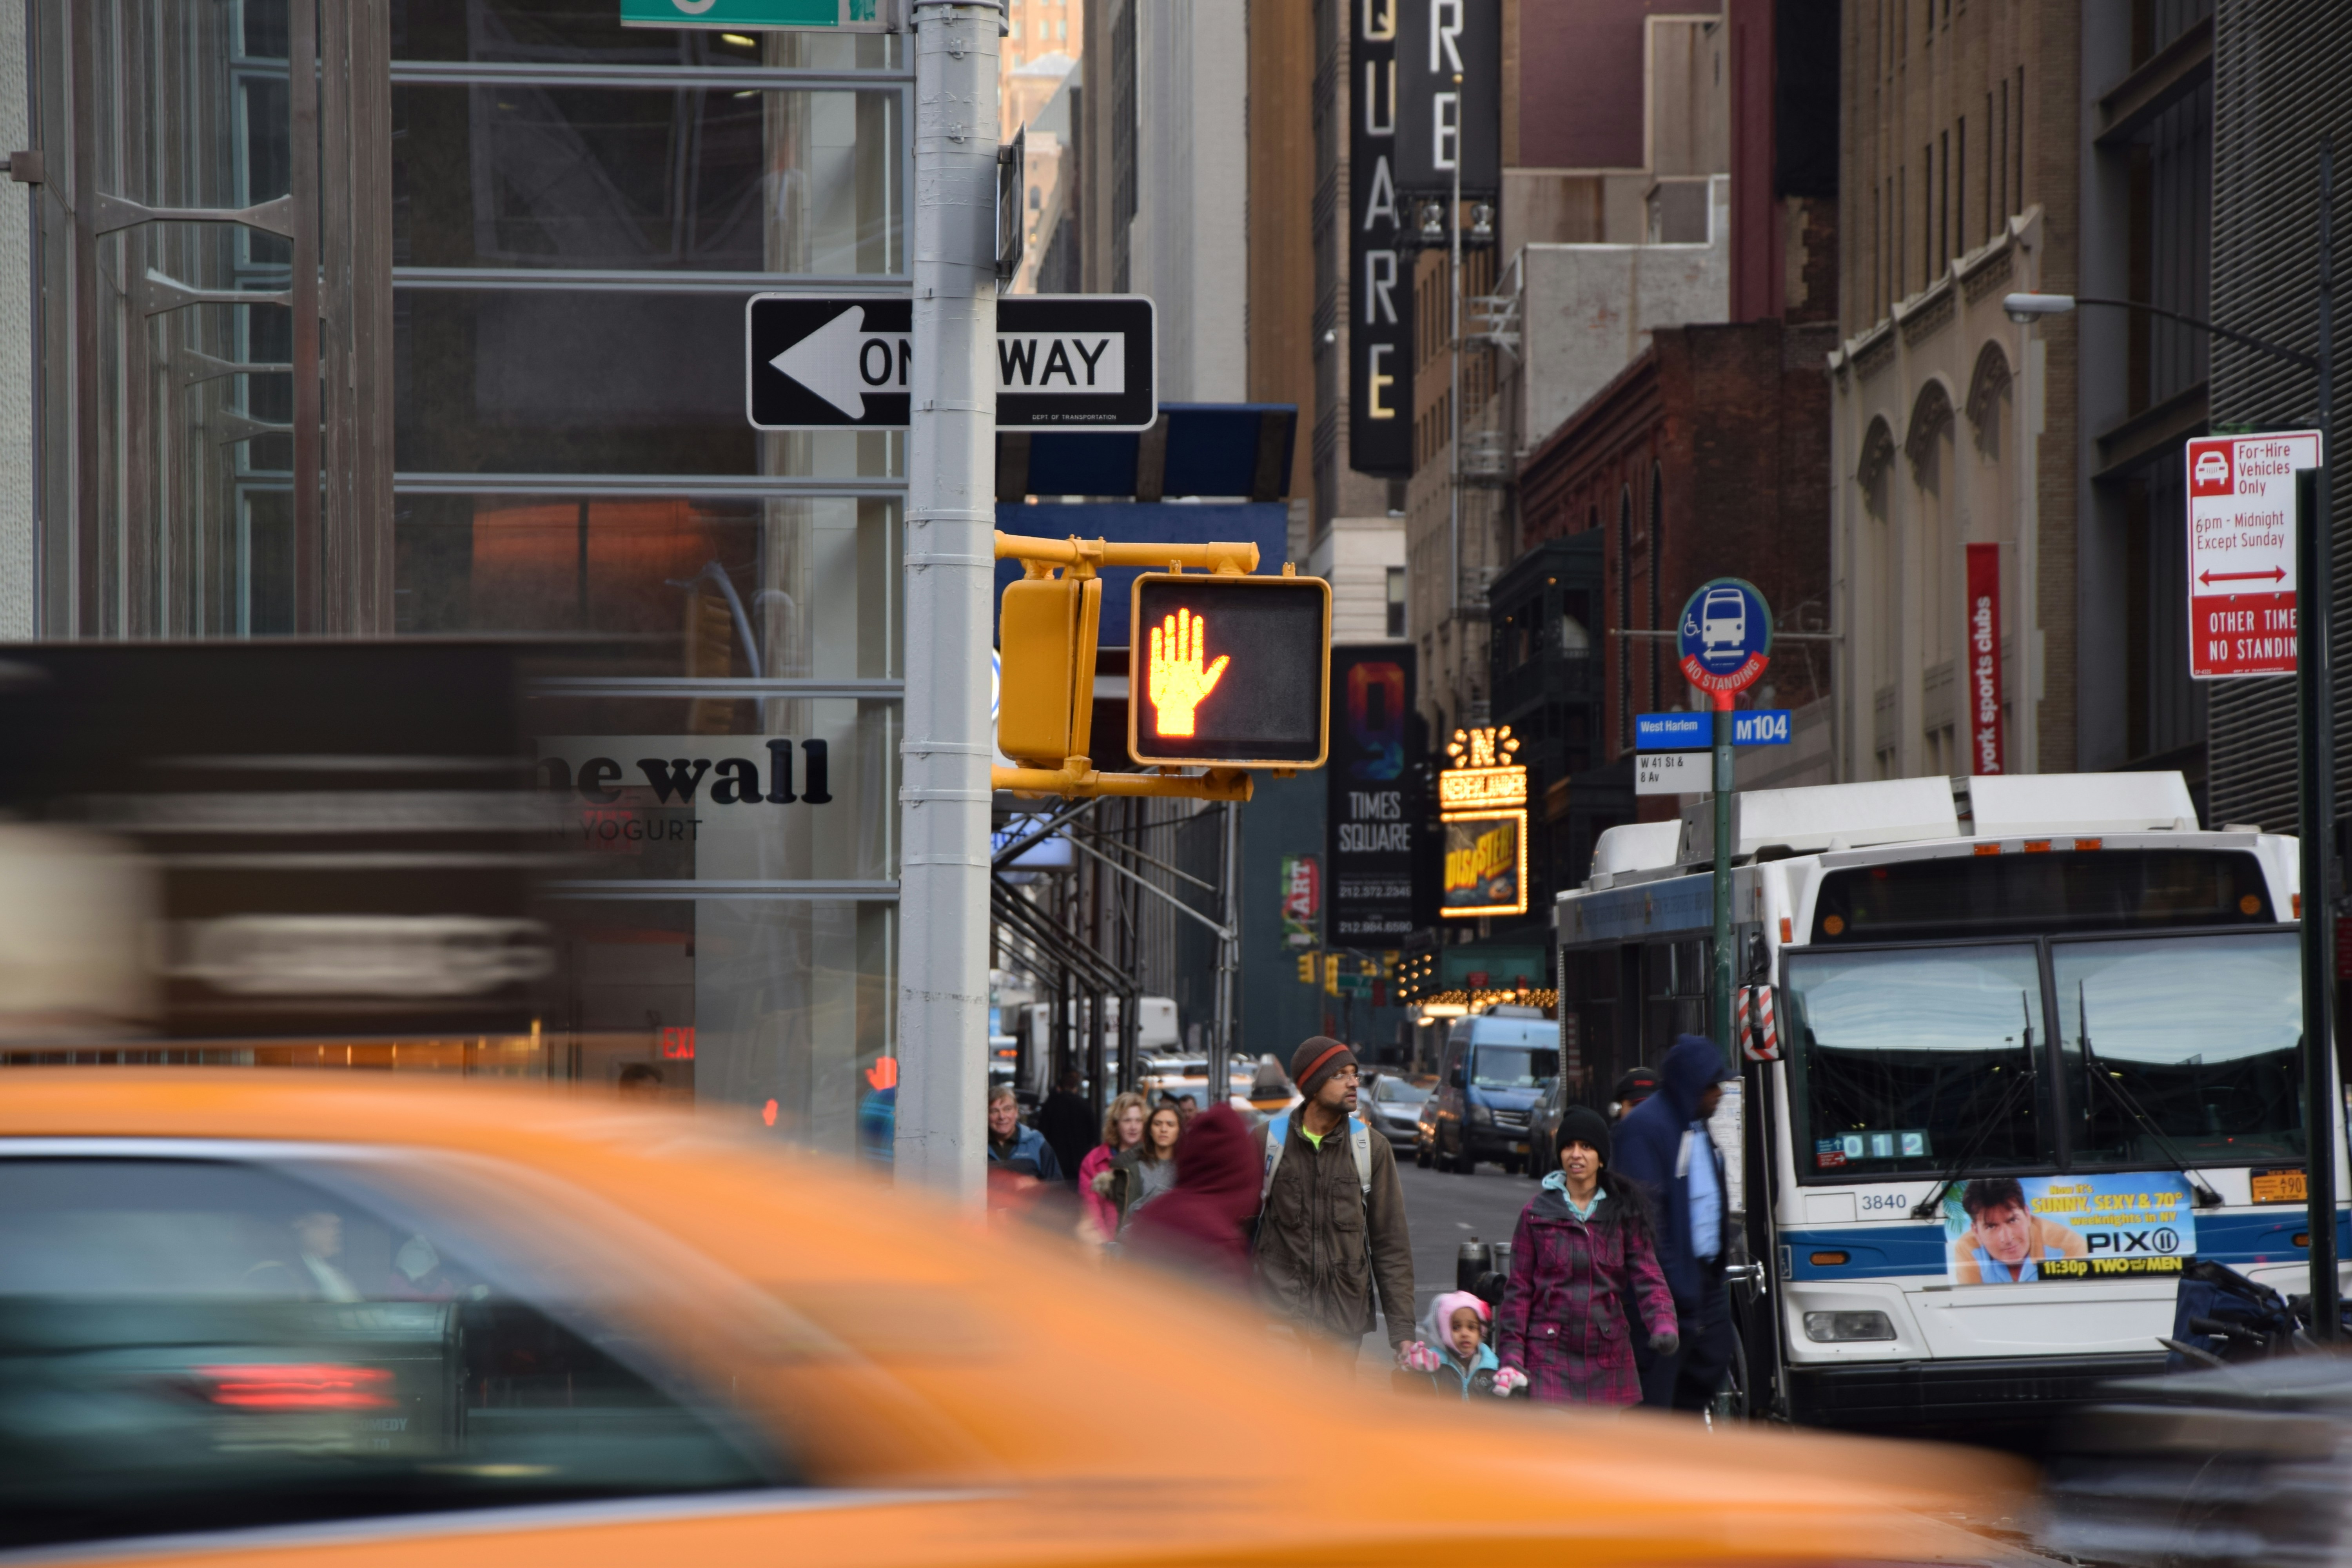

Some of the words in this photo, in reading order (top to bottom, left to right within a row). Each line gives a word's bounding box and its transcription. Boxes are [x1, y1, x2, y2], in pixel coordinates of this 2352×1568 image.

[997, 339, 1110, 386] WAY
[2239, 443, 2290, 459] For-Hire
[2239, 461, 2290, 476] Vehicles
[2239, 479, 2266, 496] Only
[2196, 517, 2222, 533] 6pm
[2235, 510, 2284, 529] Midnight
[2198, 534, 2237, 551] Except
[2242, 531, 2285, 549] Sunday
[1974, 596, 1992, 652] clubs
[2210, 611, 2254, 633] OTHER
[2265, 608, 2297, 630] TIME
[2210, 640, 2228, 661] NO
[2238, 637, 2297, 659] STANDIN
[1686, 660, 1702, 679] NO
[1702, 659, 1760, 690] STANDING
[1976, 655, 1998, 722] sports
[1641, 722, 1663, 732] West
[1666, 721, 1698, 731] Harlem
[1737, 715, 1787, 739] M104
[1470, 728, 1496, 767] N
[1978, 726, 1999, 773] york
[533, 738, 622, 804] he
[636, 739, 833, 804] wall
[1641, 758, 1649, 768] W
[1652, 758, 1661, 767] 41
[1666, 757, 1674, 767] St
[1678, 757, 1684, 766] &
[1641, 772, 1645, 782] 8
[1649, 772, 1659, 782] Av
[1350, 791, 1401, 820] TIMES
[580, 819, 703, 841] YOGURT
[1339, 824, 1412, 852] SQUARE
[663, 1027, 694, 1058] EXI
[2050, 1185, 2073, 1195] Now
[2076, 1184, 2093, 1194] it's
[1862, 1194, 1907, 1210] 3840
[2031, 1196, 2092, 1213] SUNNY,
[2094, 1194, 2136, 1210] SEXY
[2138, 1193, 2151, 1208] &
[2070, 1213, 2142, 1227] weeknights
[2145, 1212, 2156, 1223] in
[2160, 1212, 2177, 1222] NY
[2086, 1231, 2152, 1253] PIX
[2043, 1260, 2088, 1276] 11:30p
[2092, 1258, 2130, 1273] TWO
[2147, 1257, 2183, 1271] MEN
